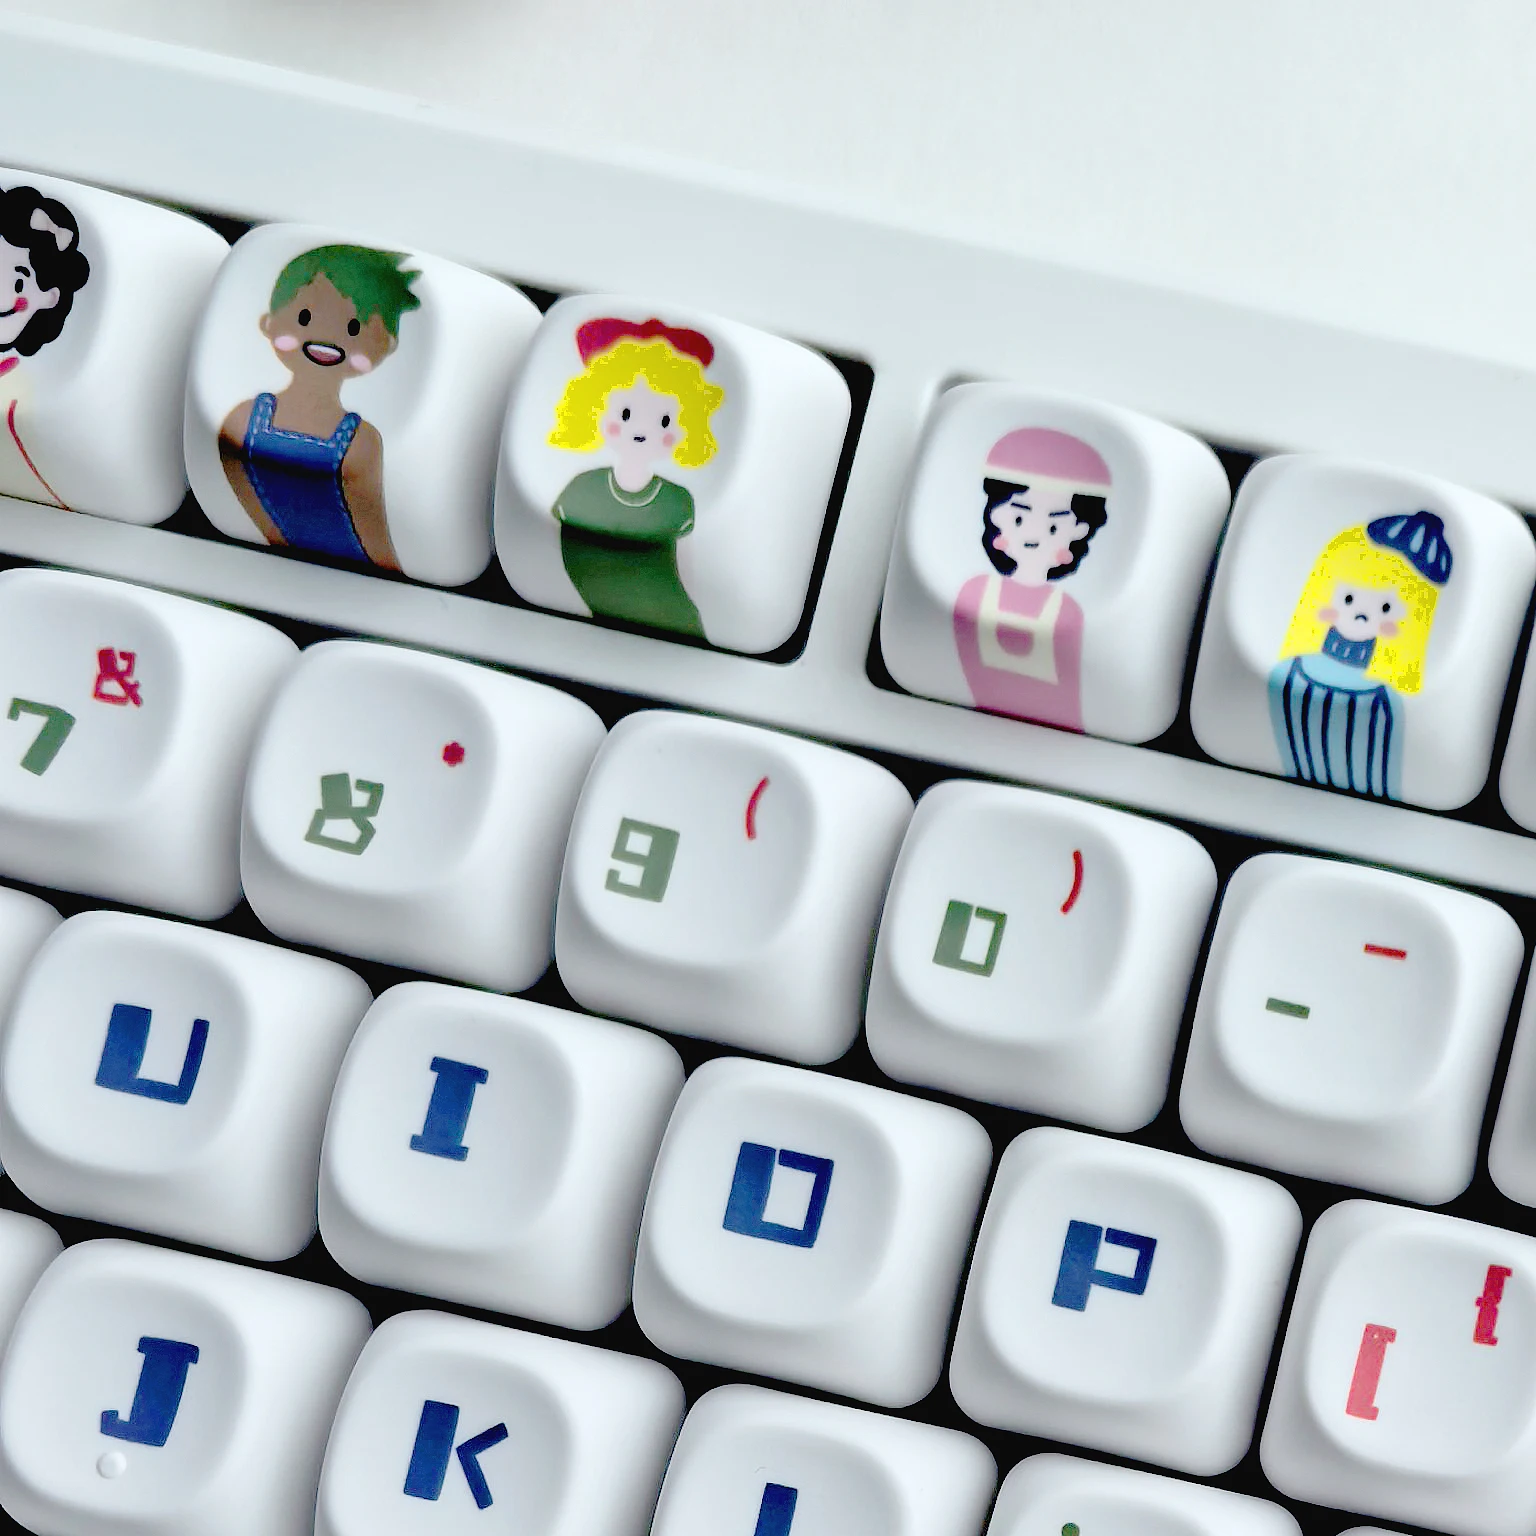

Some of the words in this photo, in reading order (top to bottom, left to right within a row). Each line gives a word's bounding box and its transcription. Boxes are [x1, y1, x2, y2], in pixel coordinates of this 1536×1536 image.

[92, 647, 143, 707] &
[8, 698, 76, 776] 7
[305, 773, 384, 855] 8
[605, 817, 680, 902] 9
[95, 1003, 210, 1105] U
[410, 1056, 489, 1161] I
[1052, 1220, 1158, 1312] P
[100, 1336, 200, 1447] J
[403, 1400, 508, 1510] K
